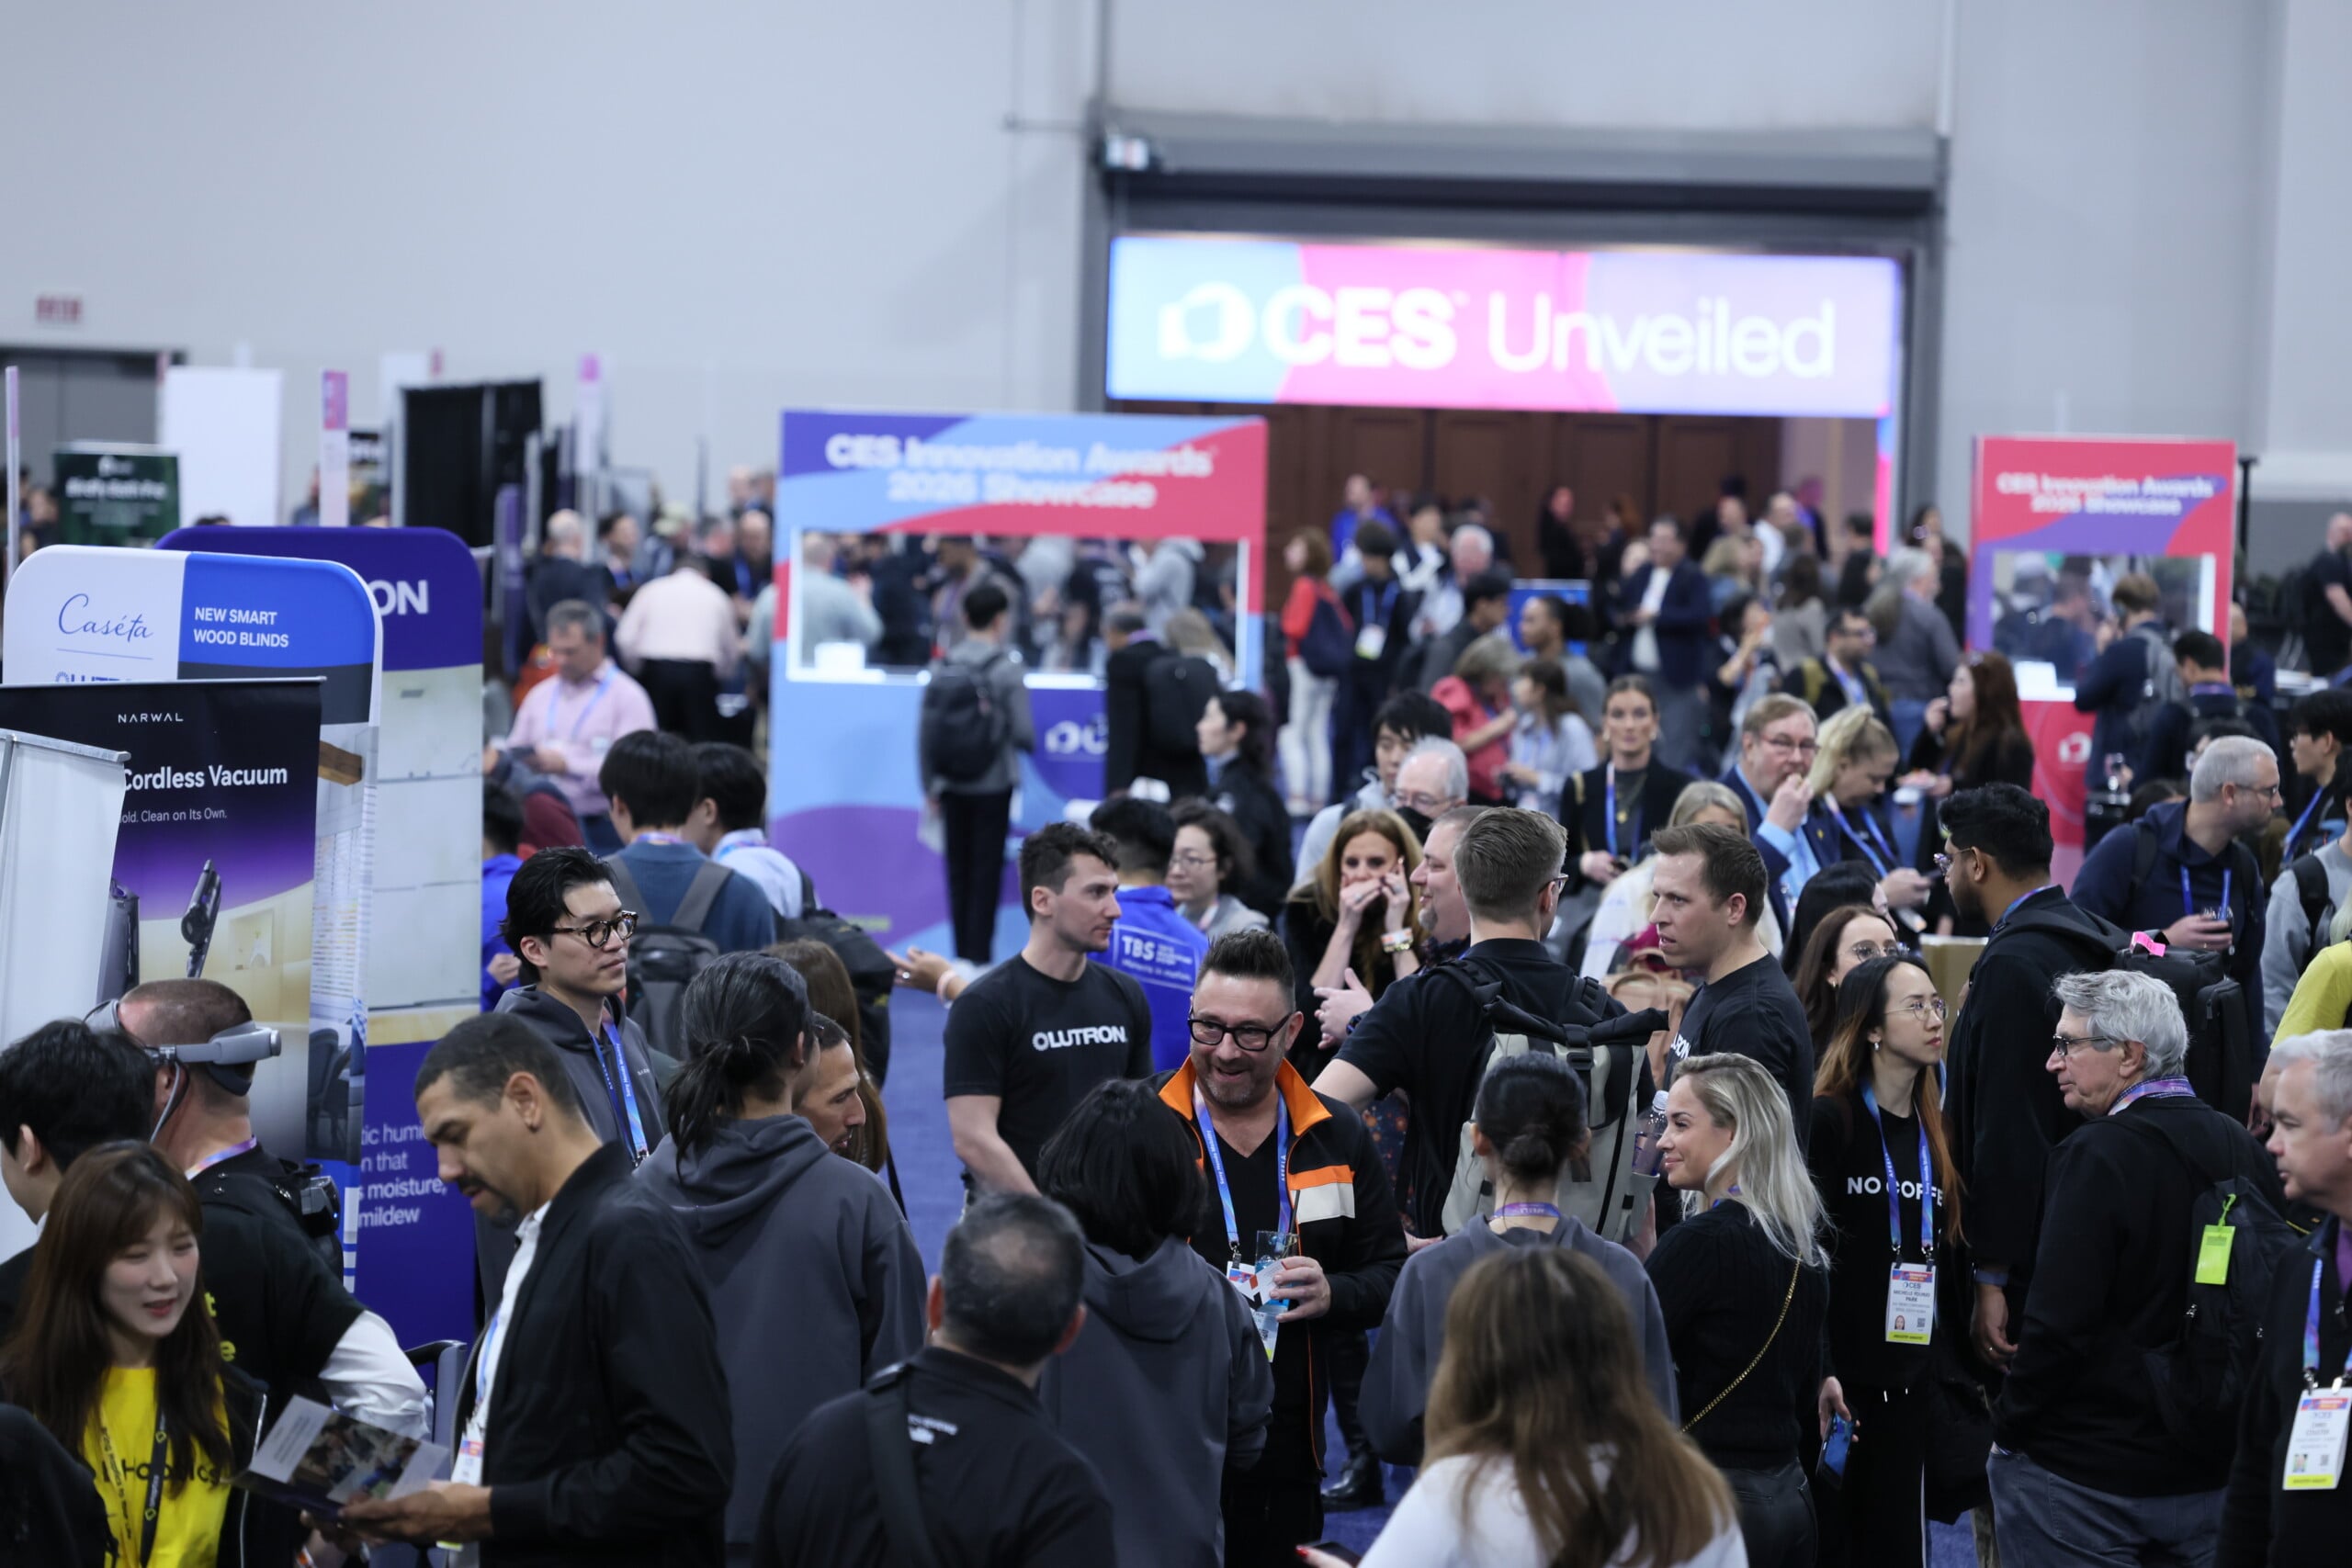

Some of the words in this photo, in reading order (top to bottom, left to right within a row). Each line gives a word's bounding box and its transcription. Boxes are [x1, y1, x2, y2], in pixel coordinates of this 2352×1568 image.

[1261, 286, 1456, 369] CES
[1488, 293, 1835, 378] Unveiled
[826, 434, 901, 468] CES
[906, 437, 1079, 472] Innovation
[1085, 443, 1214, 478] Awards
[983, 472, 1157, 509] Showcase
[58, 593, 153, 643] Caséta
[195, 607, 227, 623] NEW
[229, 609, 277, 625] SMART
[193, 628, 236, 645] WOOD
[240, 631, 288, 648] BLINDS
[118, 713, 184, 723] NARWAL
[124, 766, 205, 791] Cordless
[209, 765, 288, 786] Vacuum
[120, 810, 139, 823] old.
[141, 809, 169, 822] Clean
[173, 811, 187, 821] on
[189, 808, 201, 820] Its
[204, 807, 227, 819] Own.
[1122, 936, 1155, 961] TBS
[383, 1123, 425, 1144] humi
[1204, 1129, 1216, 1152] Mobility
[377, 1151, 407, 1171] that
[1212, 1152, 1222, 1170] Honda
[368, 1177, 447, 1200] moisture,
[1848, 1177, 1881, 1194] NO
[358, 1205, 421, 1228] mildew
